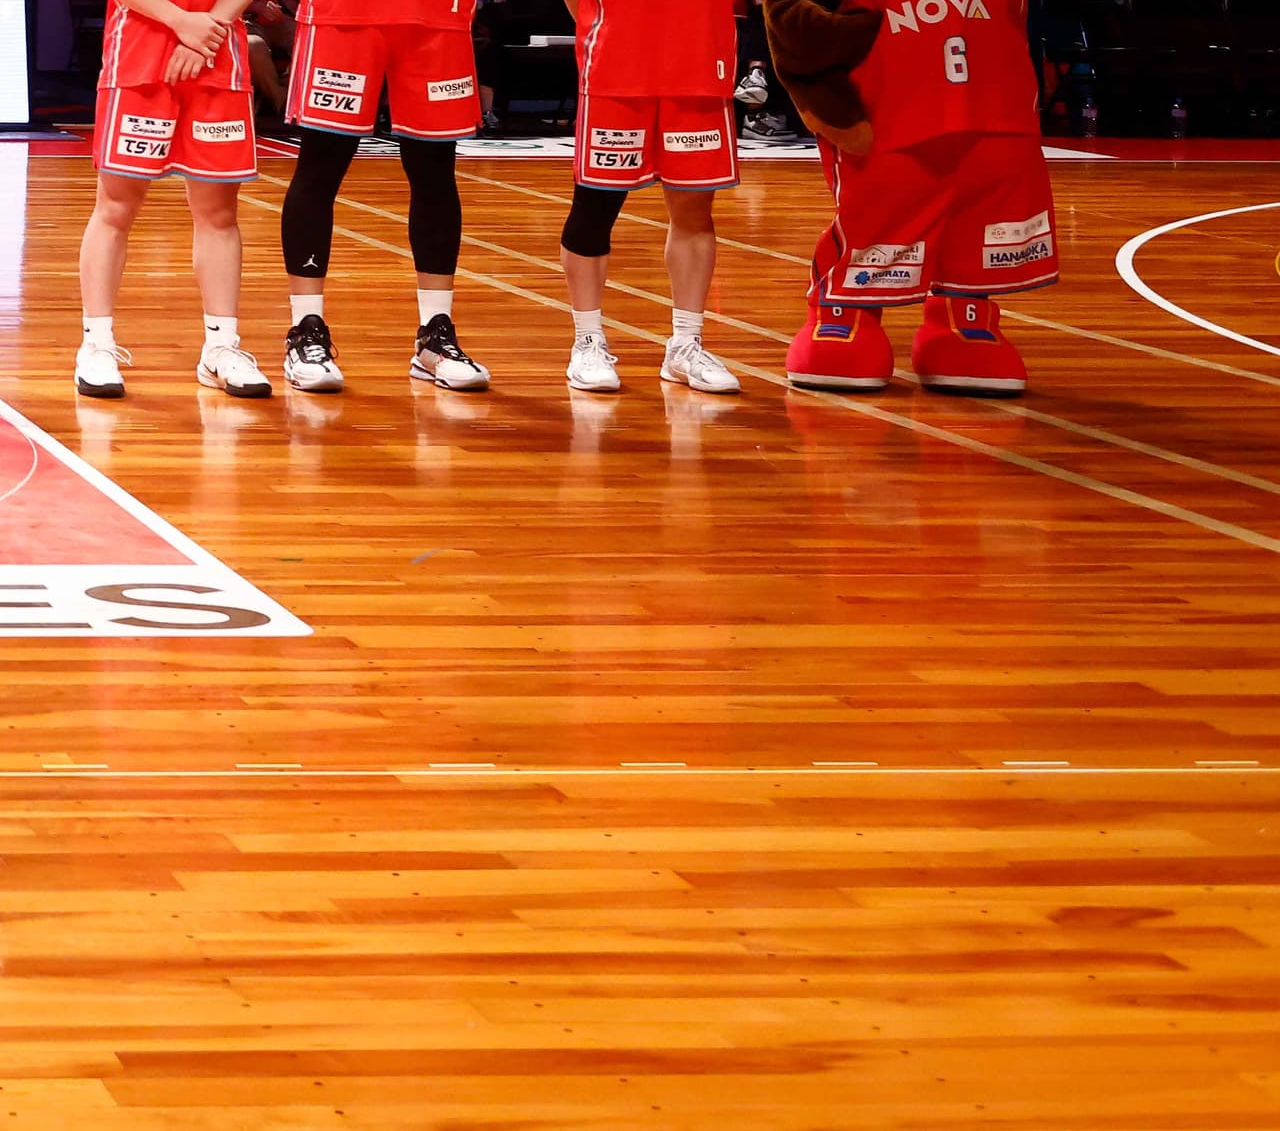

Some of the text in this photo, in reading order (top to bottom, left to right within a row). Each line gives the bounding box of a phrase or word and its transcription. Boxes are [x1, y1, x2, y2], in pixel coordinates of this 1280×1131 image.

[943, 36, 969, 83] 6
[202, 124, 243, 134] YOSHINO
[674, 134, 719, 144] YOSHINO
[966, 304, 976, 321] 6
